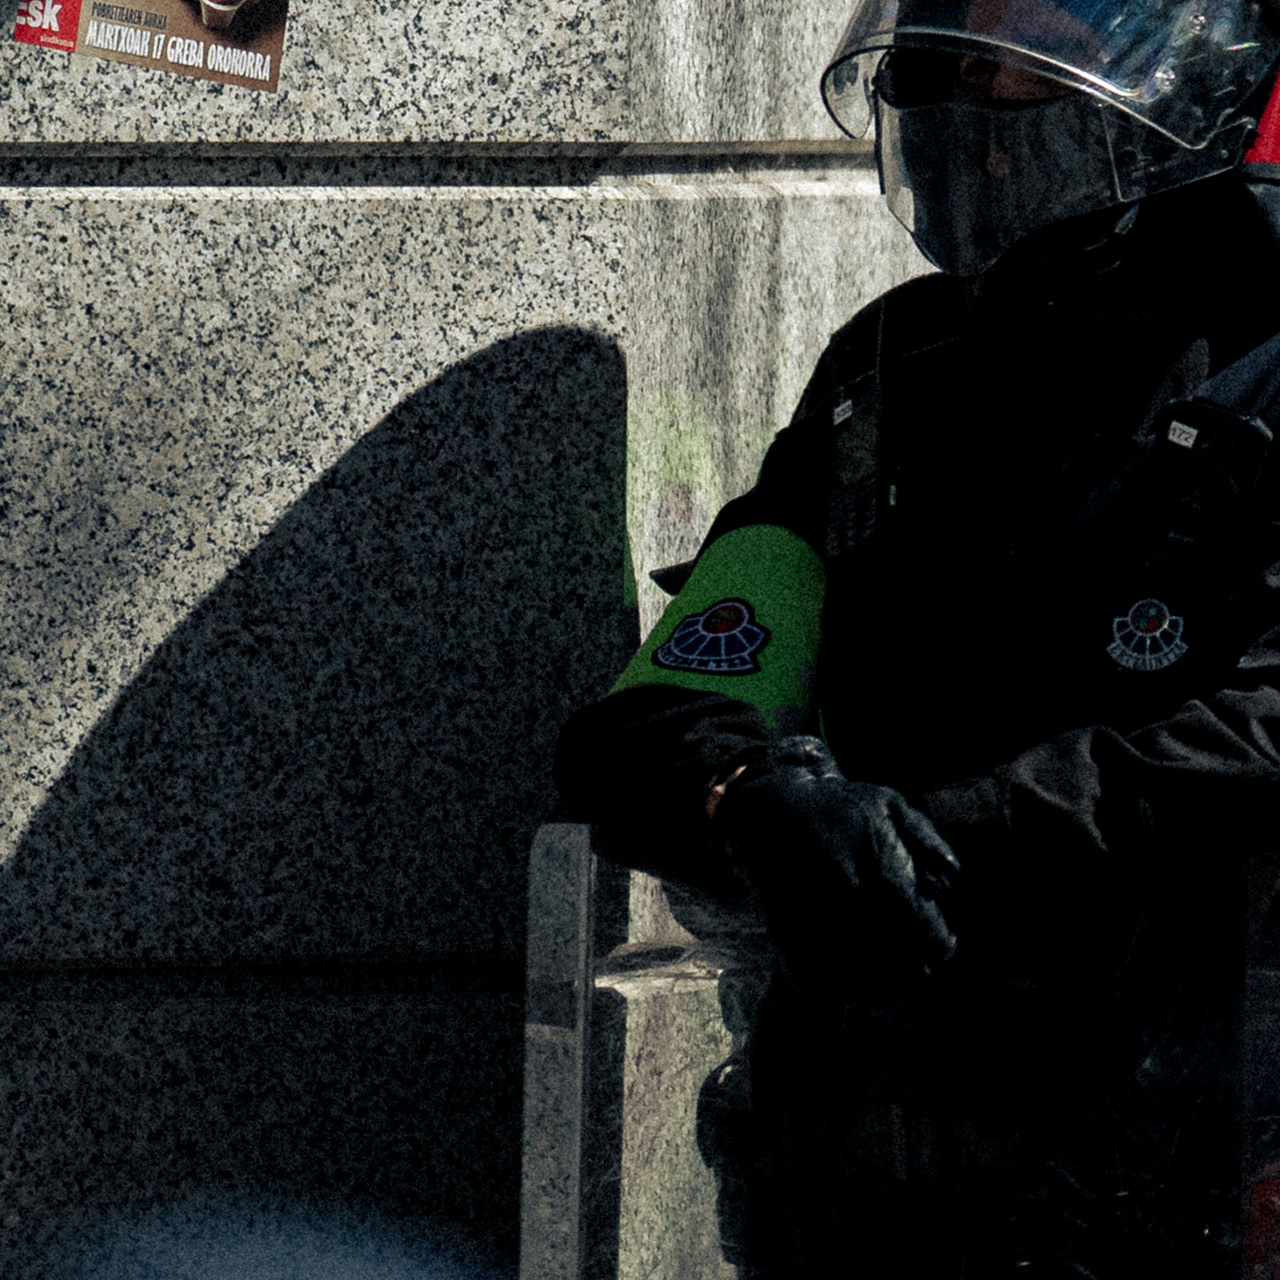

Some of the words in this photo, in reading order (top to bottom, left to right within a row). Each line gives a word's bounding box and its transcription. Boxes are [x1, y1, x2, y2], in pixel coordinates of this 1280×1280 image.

[143, 12, 168, 30] AURKA
[85, 20, 151, 57] MARTXOAK
[152, 33, 166, 60] 17
[166, 36, 204, 68] GREBA
[207, 43, 271, 82] OROKORRA
